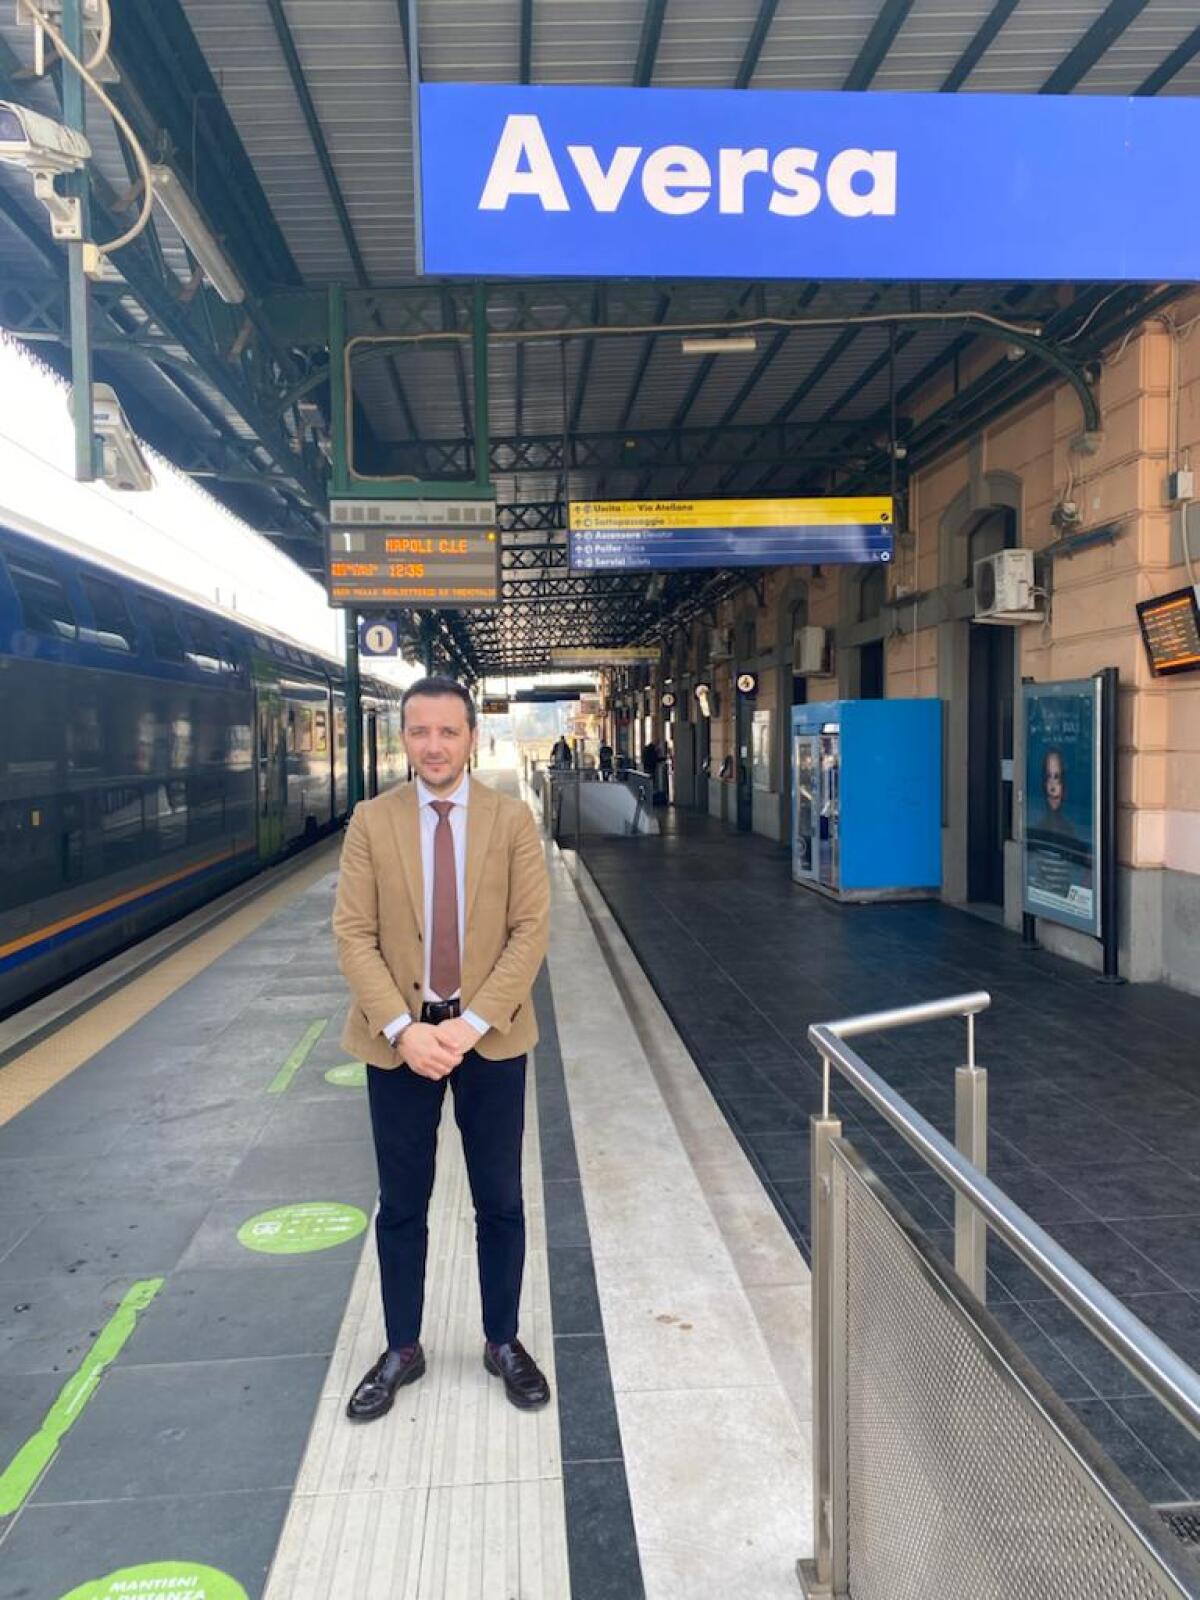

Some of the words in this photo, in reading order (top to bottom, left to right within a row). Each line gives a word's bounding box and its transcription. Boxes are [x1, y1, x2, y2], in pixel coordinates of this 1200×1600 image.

[478, 113, 898, 217] Aversa
[593, 504, 621, 512] Uscita
[343, 532, 350, 552] 1
[385, 538, 433, 553] NAPOLI
[375, 630, 384, 648] 1
[109, 1576, 198, 1593] MANTIENI
